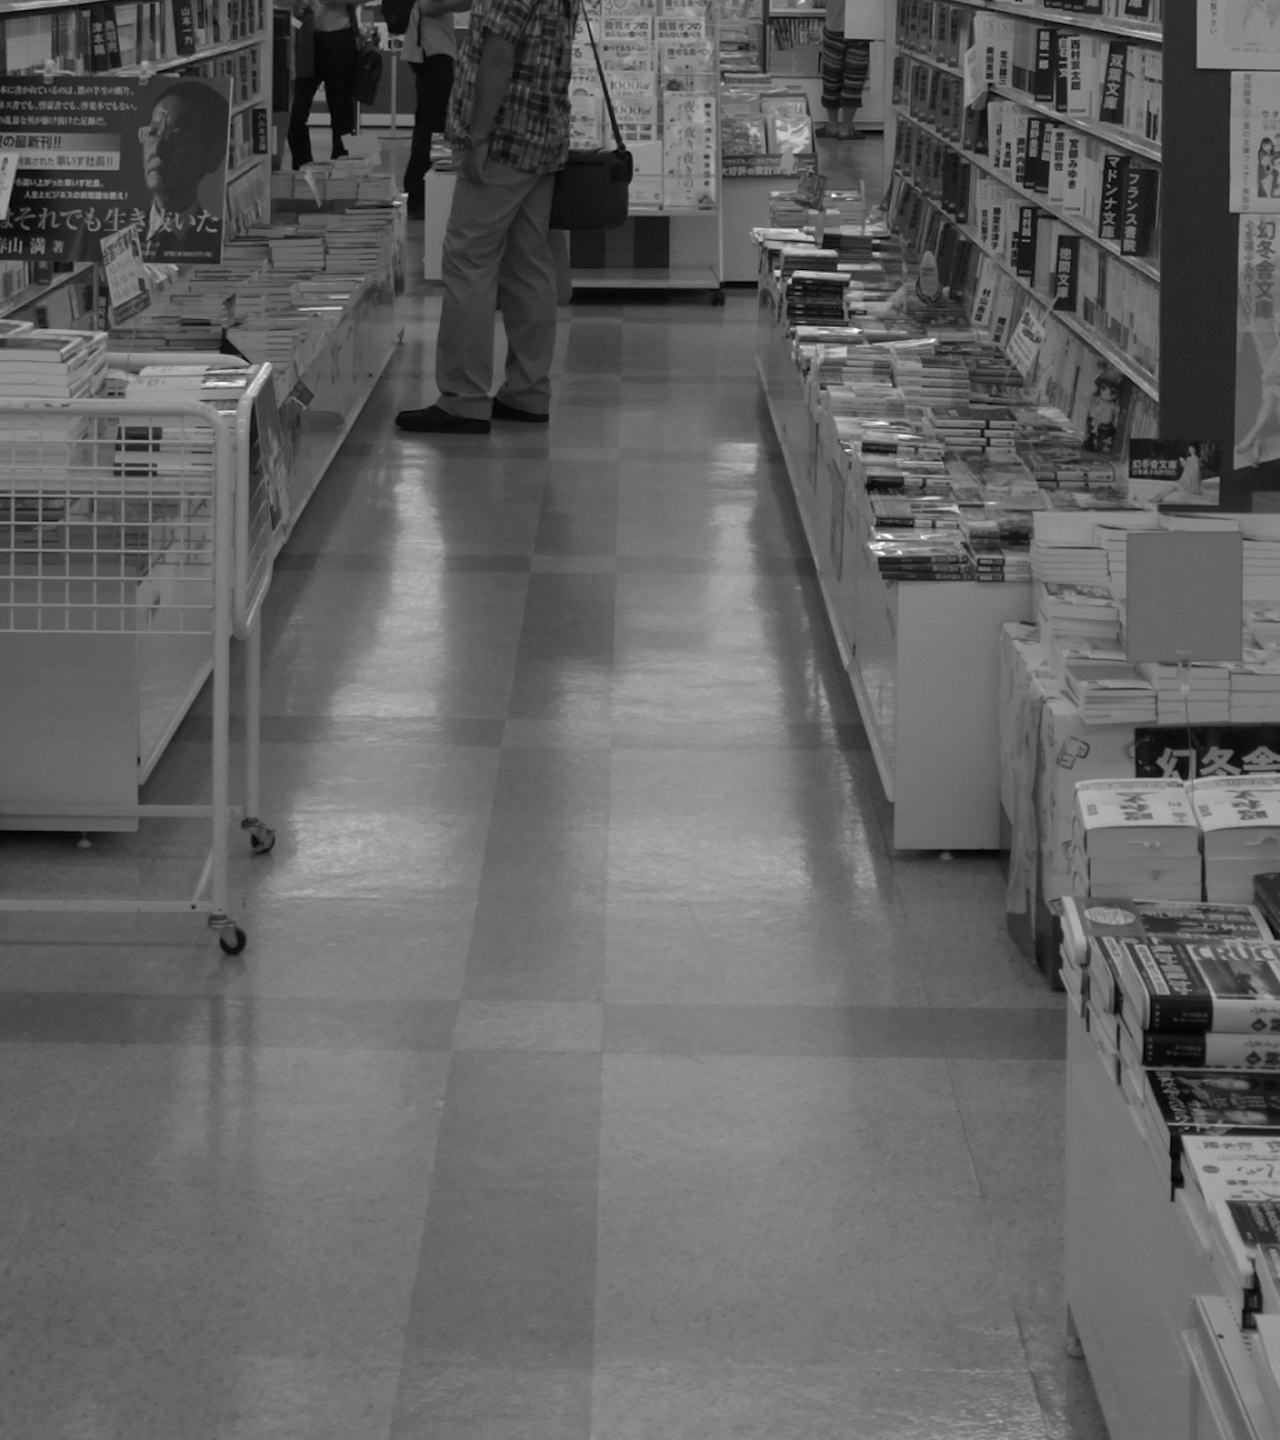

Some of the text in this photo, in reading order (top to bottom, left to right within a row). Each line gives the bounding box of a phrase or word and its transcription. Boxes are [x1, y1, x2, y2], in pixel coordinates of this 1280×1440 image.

[180, 6, 194, 46] 山本一力
[1105, 54, 1124, 111] 双葉文庫
[1101, 155, 1120, 240] マドンナ文庫
[1123, 171, 1140, 254] フランス書院
[51, 239, 66, 254] 著
[1256, 220, 1278, 321] 幻冬舎文庫
